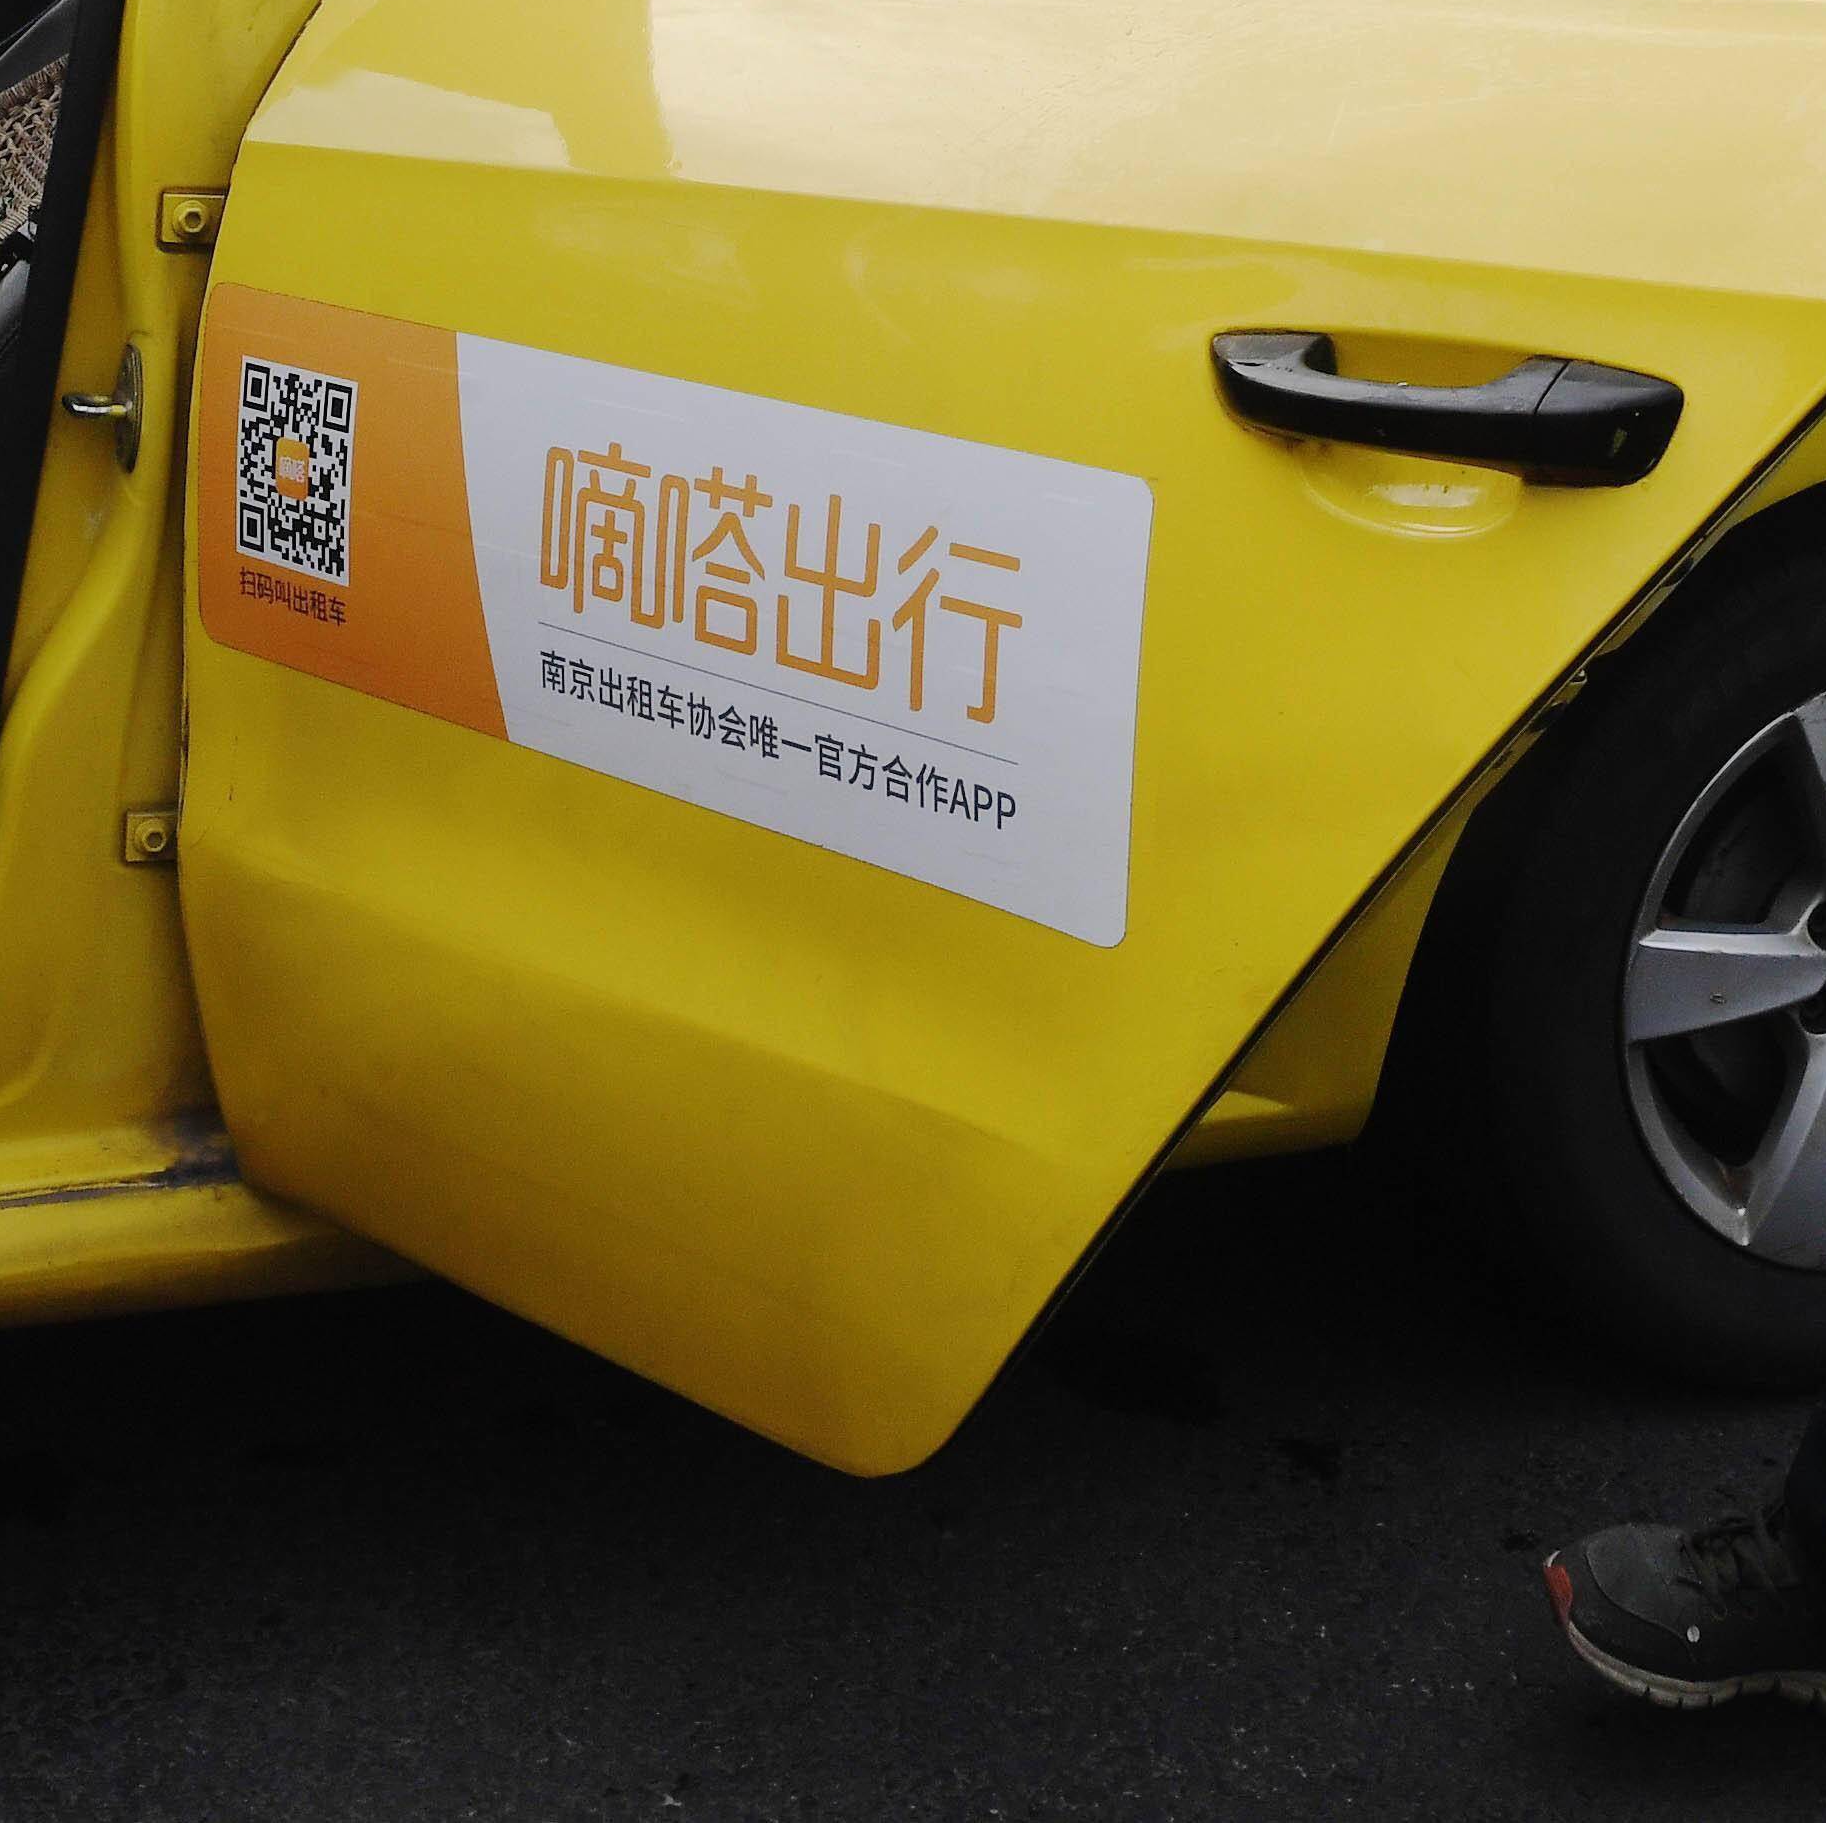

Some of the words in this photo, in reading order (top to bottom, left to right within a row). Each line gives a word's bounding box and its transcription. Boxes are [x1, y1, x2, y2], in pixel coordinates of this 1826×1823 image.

[240, 565, 346, 626] 扫码叫出租车
[540, 442, 1023, 724] 嘀嗒出行
[540, 650, 1016, 829] 南京出租车协会唯一官方合作APP
